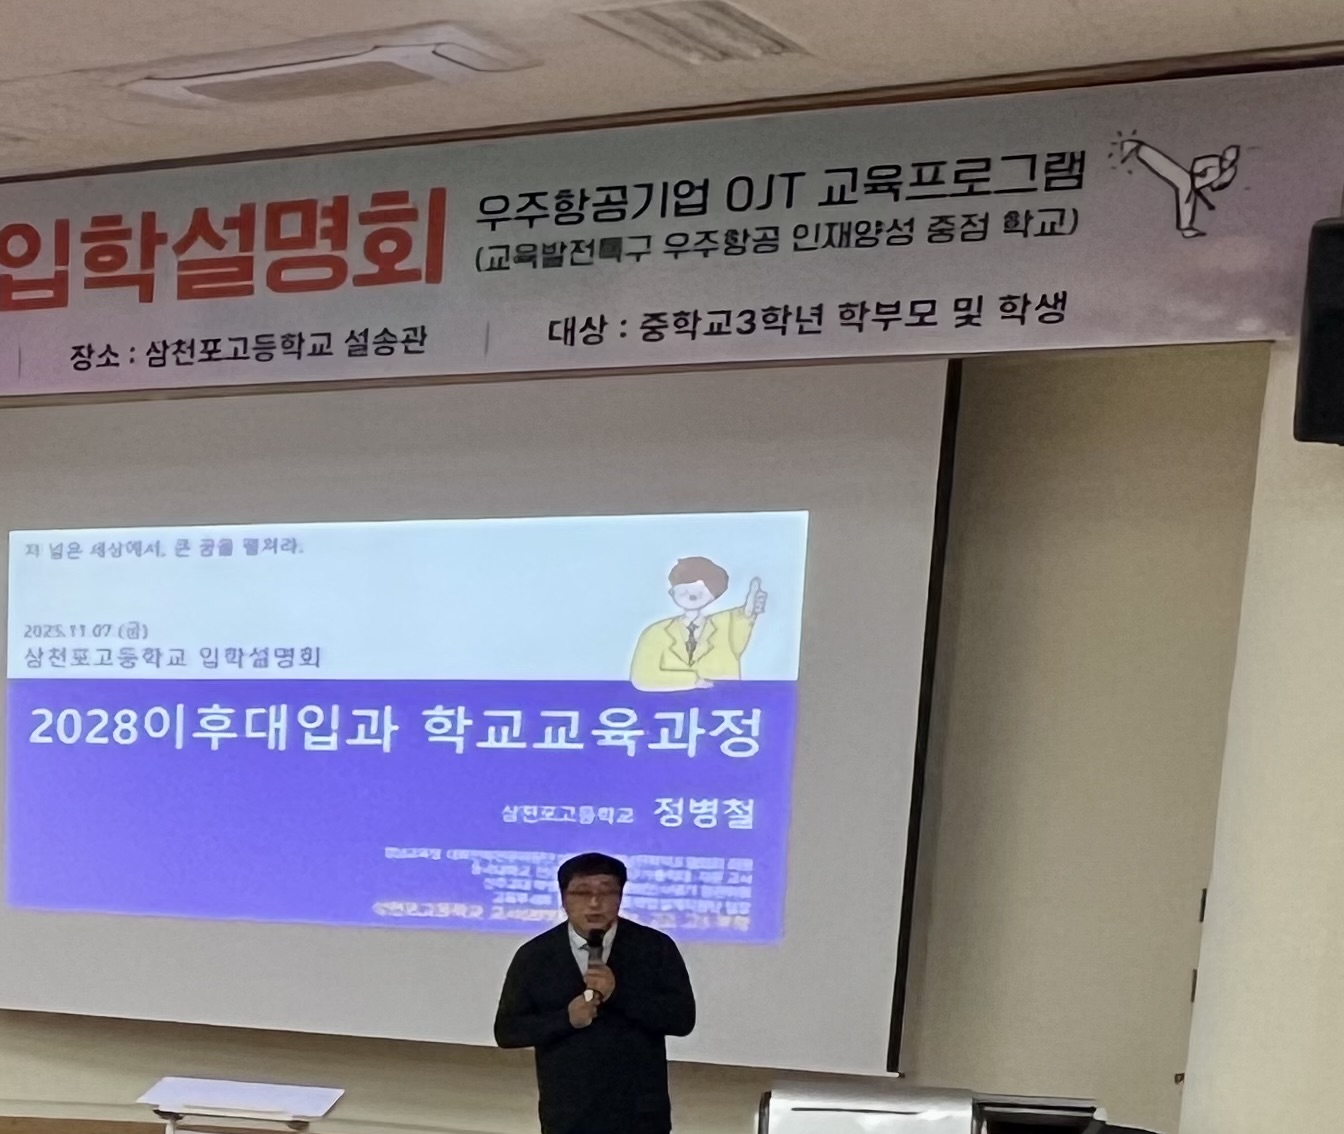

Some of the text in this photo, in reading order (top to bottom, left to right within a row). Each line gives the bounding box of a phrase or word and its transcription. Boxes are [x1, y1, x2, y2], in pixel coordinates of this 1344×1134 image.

[476, 150, 1086, 231] 우주항공기업 OJT 교육프로그램
[663, 225, 781, 260] 우주항공
[792, 217, 915, 252] 인재양성
[927, 211, 990, 244] 중점
[1002, 207, 1080, 239] 학교)
[547, 314, 609, 347] 대상
[639, 302, 825, 344] 중학교3학년
[837, 297, 939, 335] 학부모
[952, 294, 985, 329] 및
[998, 289, 1068, 328] 학생
[69, 342, 121, 371] 장소
[145, 331, 335, 369] 삼천포고등학교
[344, 324, 429, 358] 설송관
[199, 645, 322, 670] 입학설명회
[28, 702, 764, 759] 2028이후대입과 학교교육과정
[653, 797, 755, 830] 정병철
